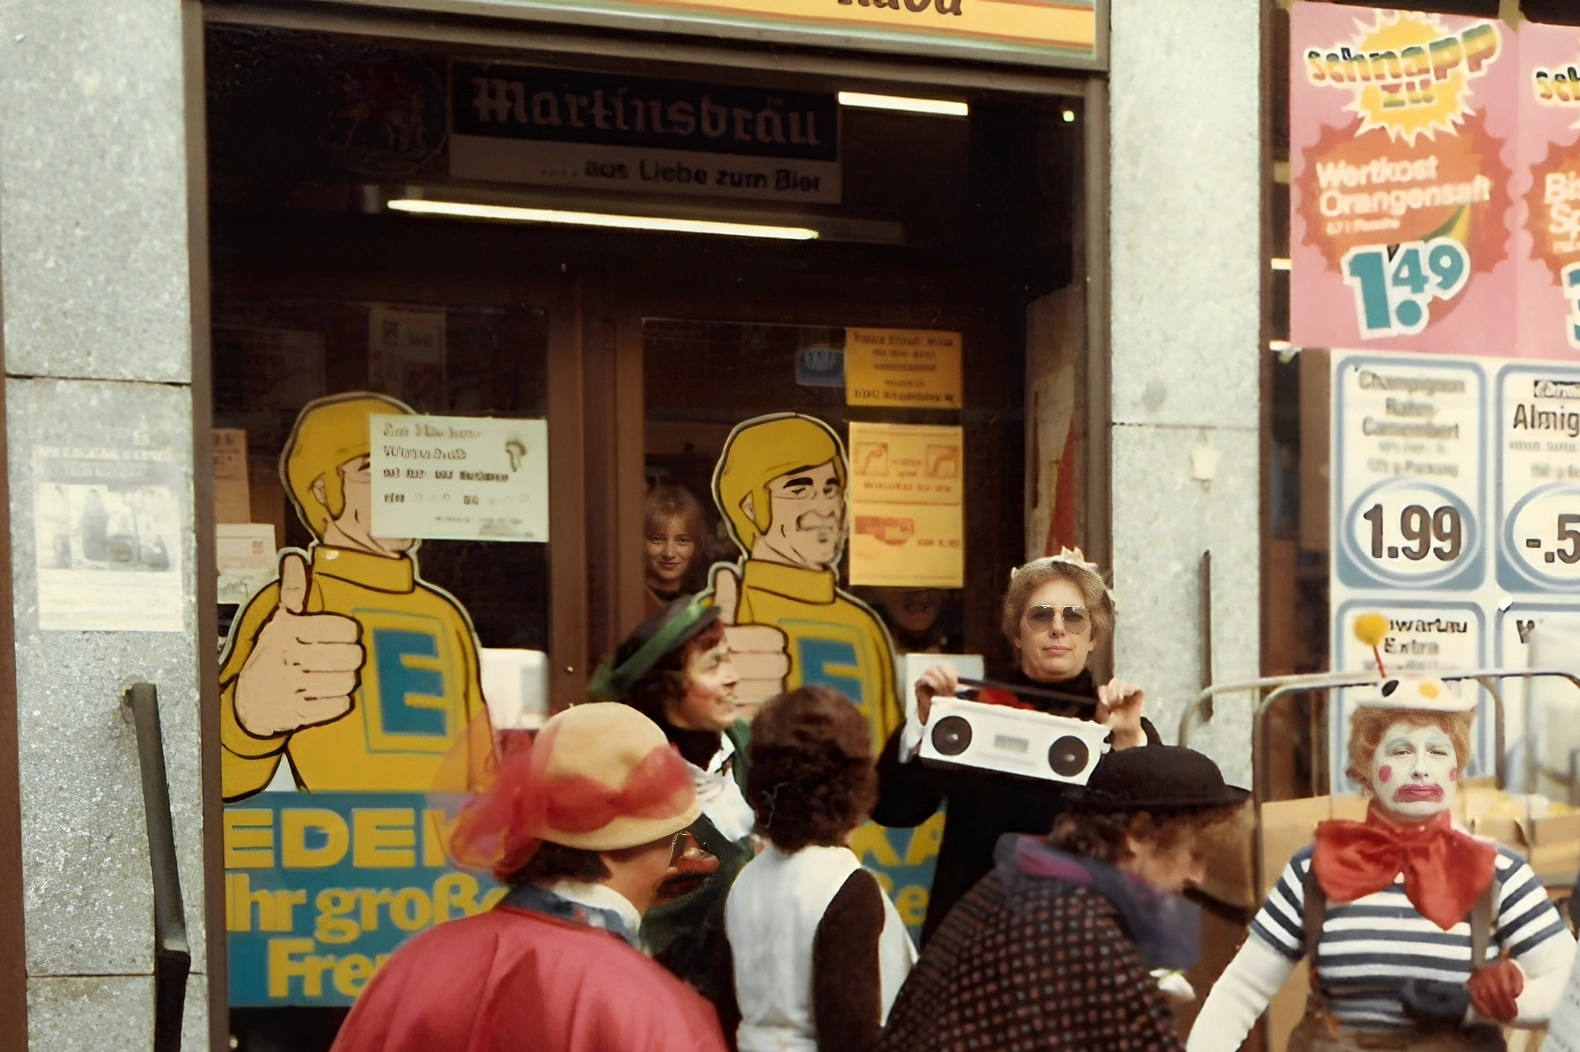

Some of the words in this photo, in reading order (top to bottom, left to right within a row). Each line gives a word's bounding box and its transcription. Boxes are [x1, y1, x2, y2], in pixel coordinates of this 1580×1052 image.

[472, 77, 820, 146] Martinsbräu
[640, 160, 706, 186] Liebe
[715, 169, 768, 189] zum
[774, 168, 820, 193] Bier
[1363, 503, 1461, 561] 1.99
[1384, 637, 1440, 655] Extra
[373, 628, 447, 737] E
